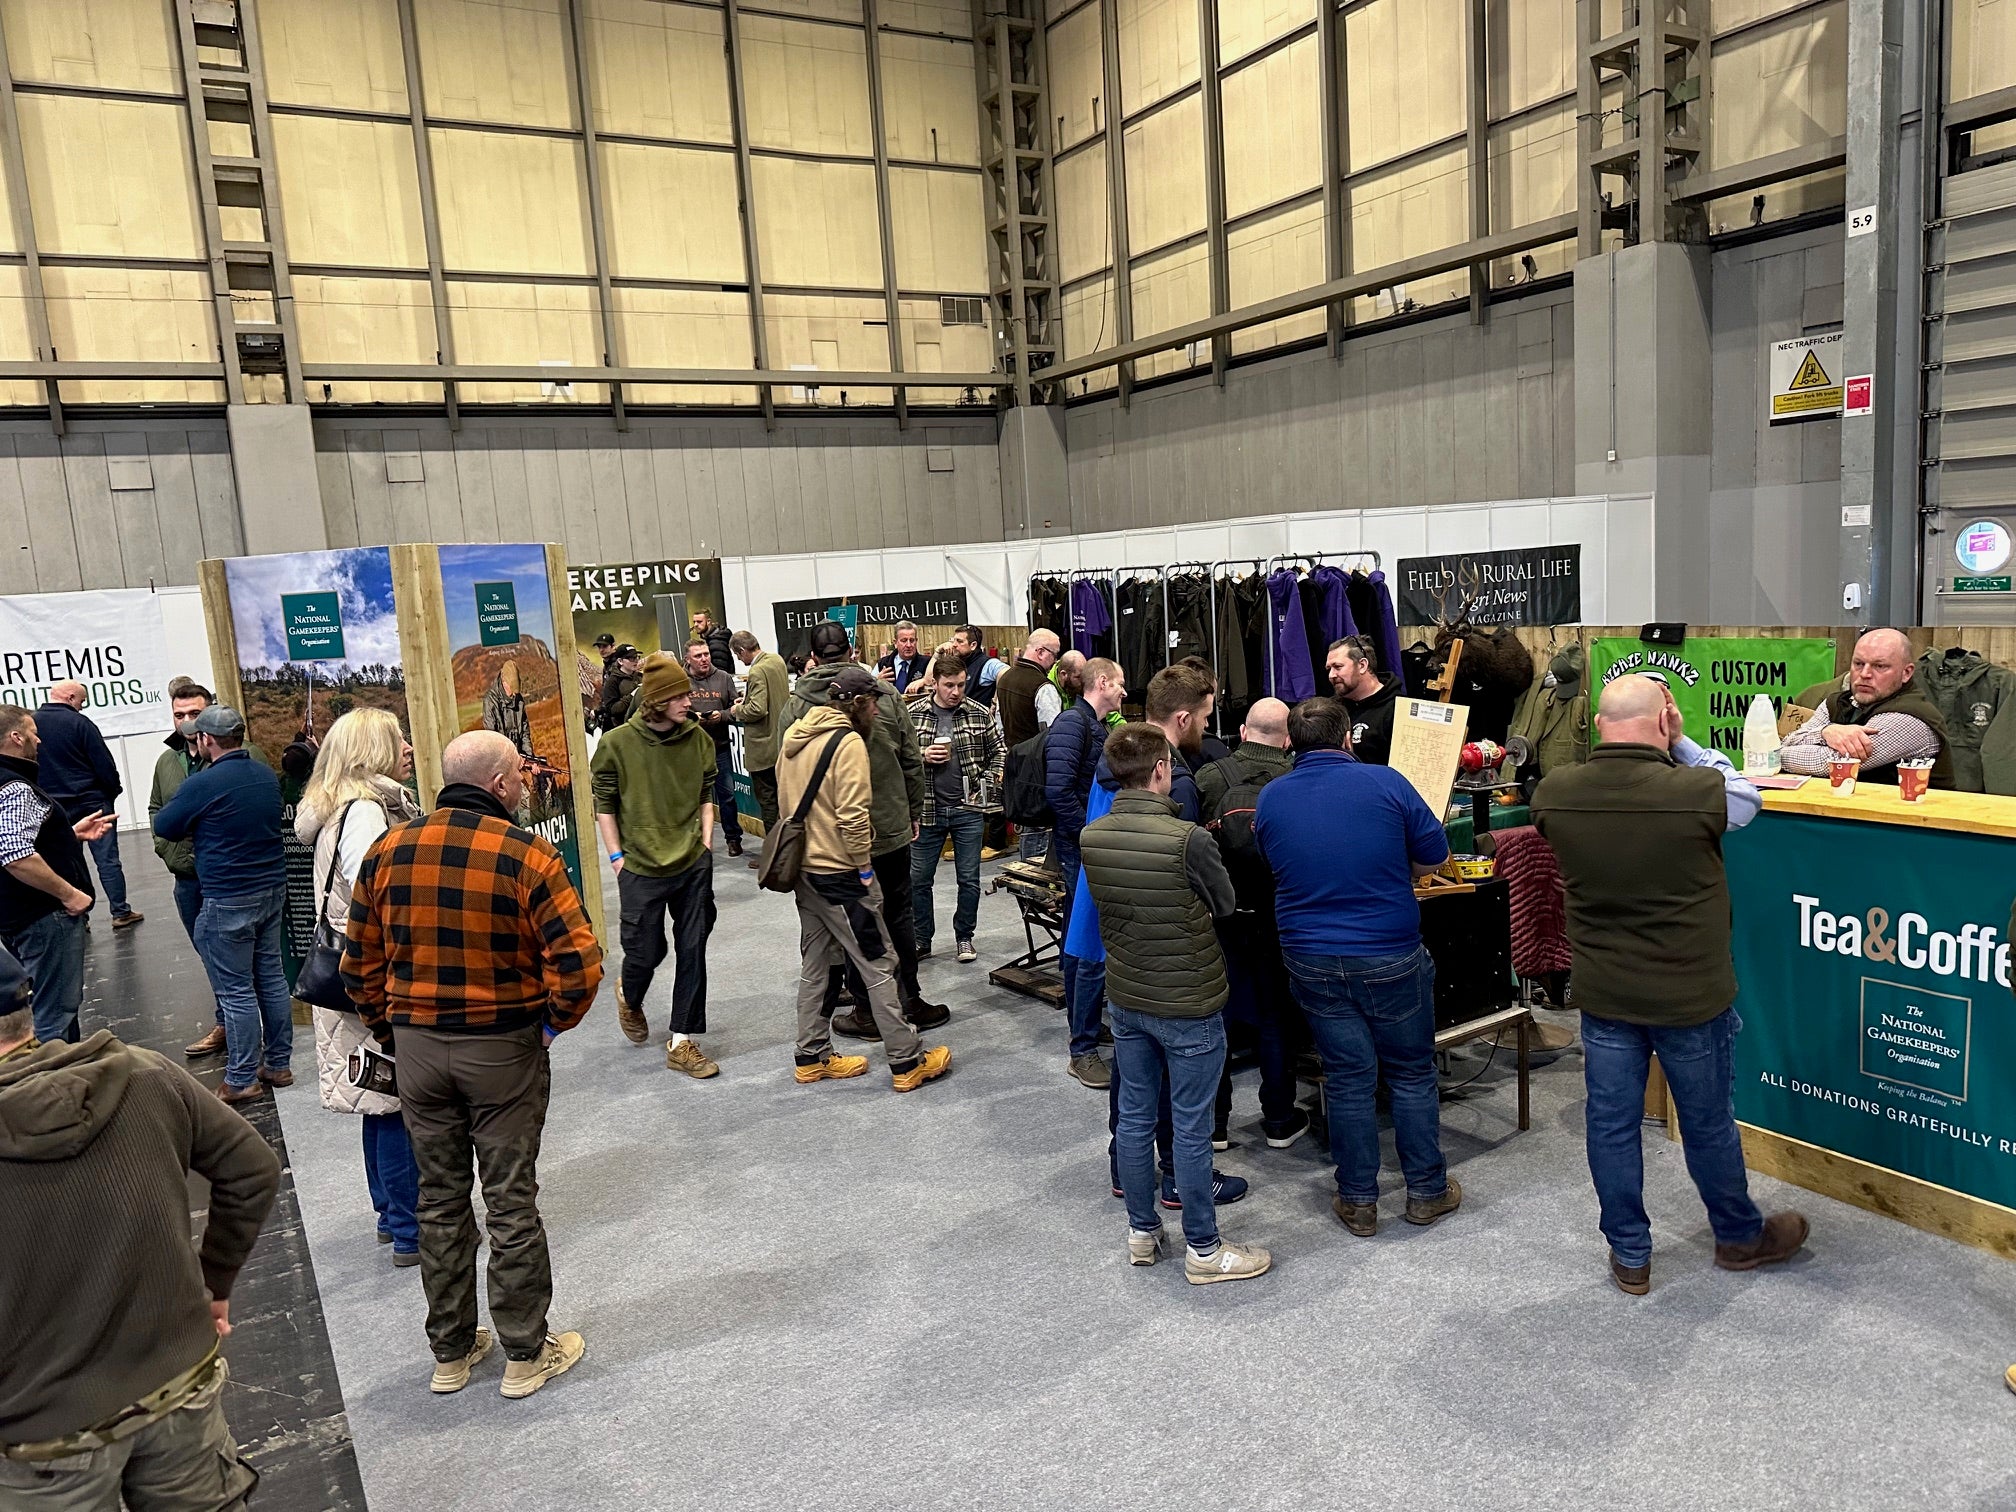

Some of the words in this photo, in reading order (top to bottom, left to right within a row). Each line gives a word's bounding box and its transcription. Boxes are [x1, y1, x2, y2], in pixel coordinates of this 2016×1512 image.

[1852, 214, 1872, 228] 5.9
[1777, 343, 1793, 351] NEC
[1795, 337, 1825, 348] TRAFFIC
[1827, 333, 1844, 343] DEP
[1408, 570, 1455, 590] FIELD
[1482, 562, 1535, 584] RURAL
[1541, 558, 1571, 578] LIFE
[483, 603, 510, 612] NATIONAL
[571, 589, 643, 612] AREA
[1493, 589, 1527, 606] News
[294, 615, 331, 624] NATIONAL
[785, 610, 829, 630] FIEL
[863, 603, 919, 623] RURAL
[925, 599, 959, 617] LIFE
[1467, 610, 1521, 625] MAGAZINE
[0, 645, 125, 686] RTEMIS
[1646, 650, 1700, 688] NANKZ
[1711, 660, 1787, 687] CUSTOM
[145, 690, 162, 704] UK
[1710, 691, 1794, 719] HANM
[1906, 1005, 1923, 1017] The
[1881, 1013, 1946, 1039] NATIONAL
[1887, 1048, 1940, 1069] Organisation
[1878, 1081, 1905, 1098] Keeping
[1906, 1089, 1918, 1099] the
[1919, 1092, 1948, 1107] Balance
[1760, 1071, 1787, 1088] ALL
[1792, 1079, 1880, 1115] DONATIONS
[1886, 1107, 1992, 1147] GRATEFULLY
